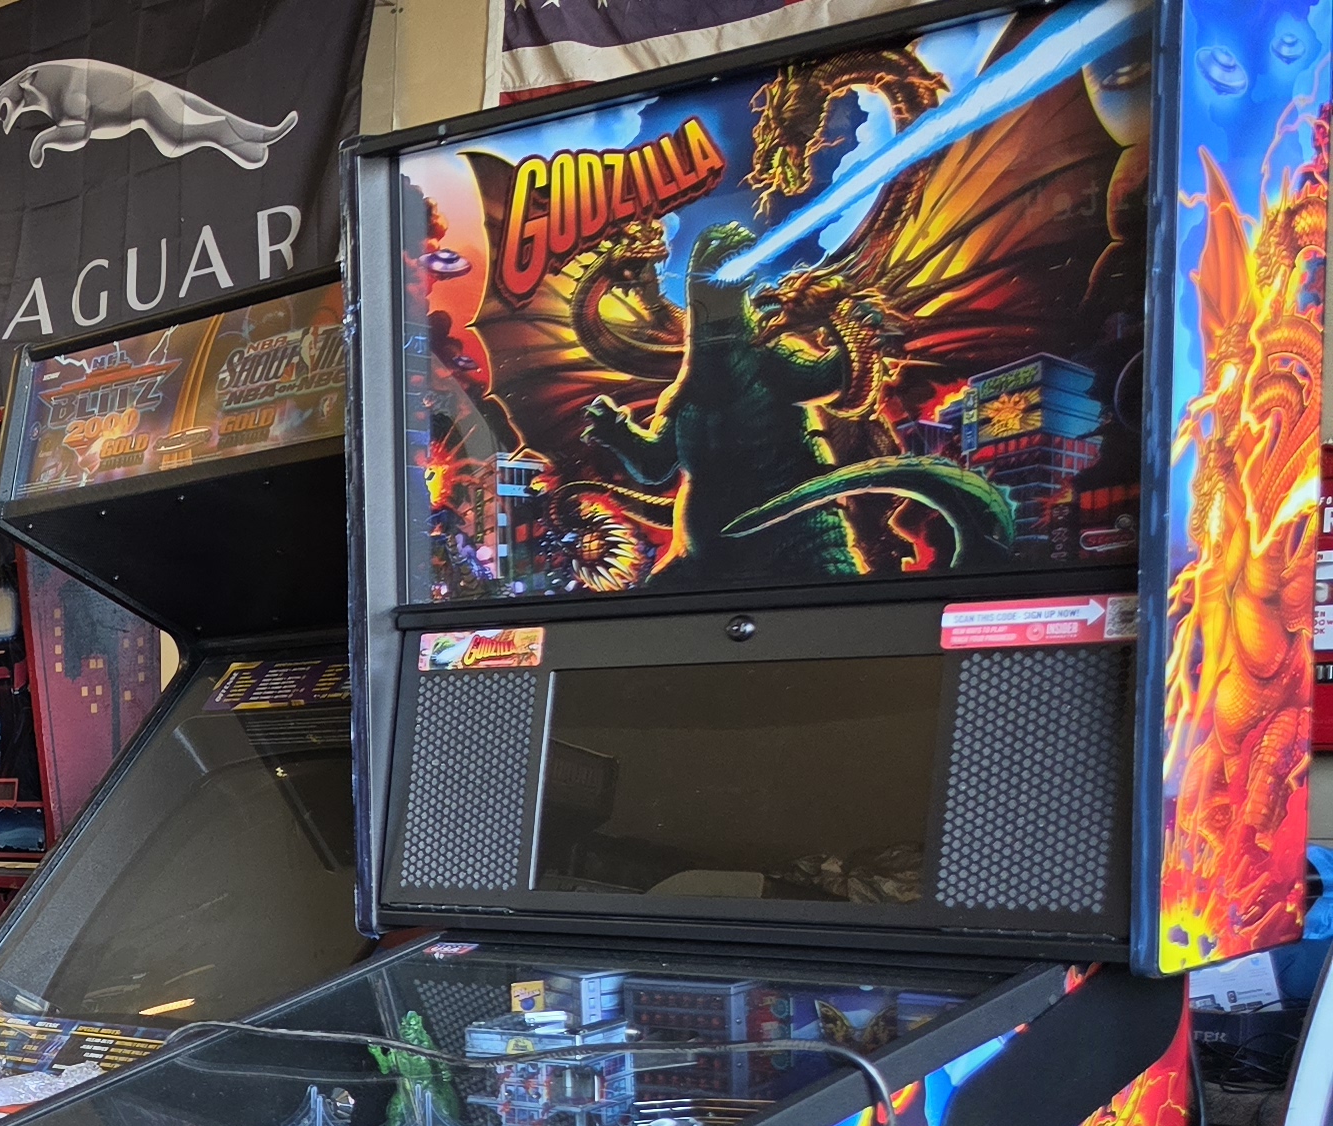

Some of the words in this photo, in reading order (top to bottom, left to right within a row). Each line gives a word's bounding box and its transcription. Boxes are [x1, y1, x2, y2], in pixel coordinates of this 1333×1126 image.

[495, 117, 725, 300] GODZILLA
[246, 335, 288, 354] NBA
[92, 350, 132, 369] NFL
[50, 373, 164, 428] BLITZ
[64, 407, 141, 443] 2000
[219, 407, 276, 436] GOLD
[100, 433, 149, 458] GOLD
[954, 613, 975, 624] SCAN
[977, 612, 995, 622] THIS
[996, 612, 1017, 621] CODE
[1023, 610, 1042, 620] SIGN
[1044, 610, 1055, 619] UP
[1057, 609, 1080, 618] NOW!
[463, 635, 517, 666] GODZILLA
